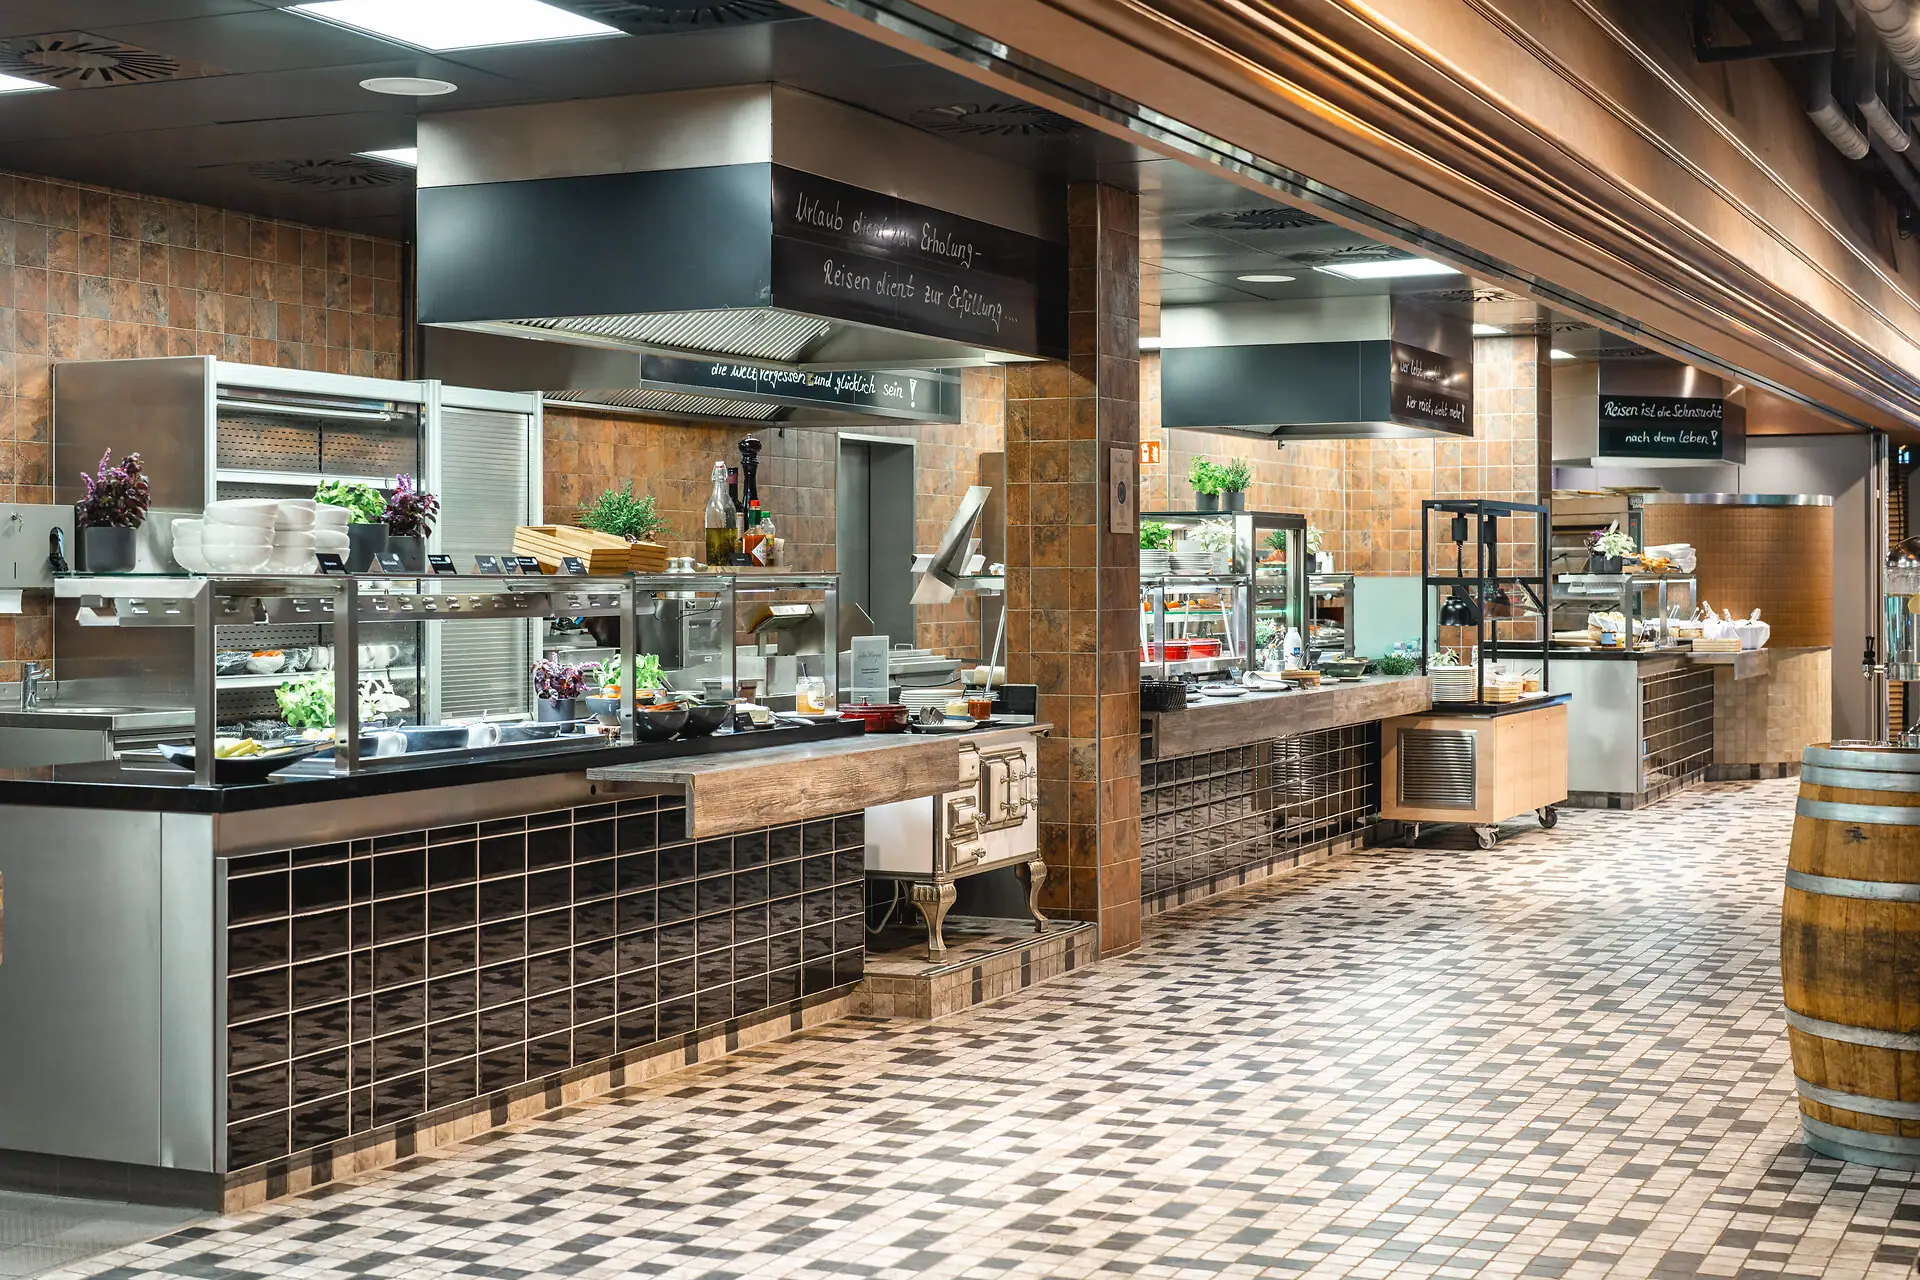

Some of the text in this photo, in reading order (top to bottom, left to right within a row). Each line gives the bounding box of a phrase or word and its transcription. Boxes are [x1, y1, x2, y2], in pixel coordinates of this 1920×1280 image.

[795, 191, 843, 231] Urlaub
[823, 259, 870, 290] Reisen
[876, 271, 915, 298] dient
[924, 285, 944, 306] zur
[711, 363, 728, 376] die
[759, 368, 806, 389] vergessen
[814, 373, 833, 388] und
[834, 373, 876, 395] glücklich
[883, 381, 904, 399] sein
[1406, 395, 1417, 409] Wer
[1604, 401, 1723, 419] Reisen ist die Sehnsucht
[1625, 431, 1650, 443] nach
[1653, 431, 1675, 443] dem
